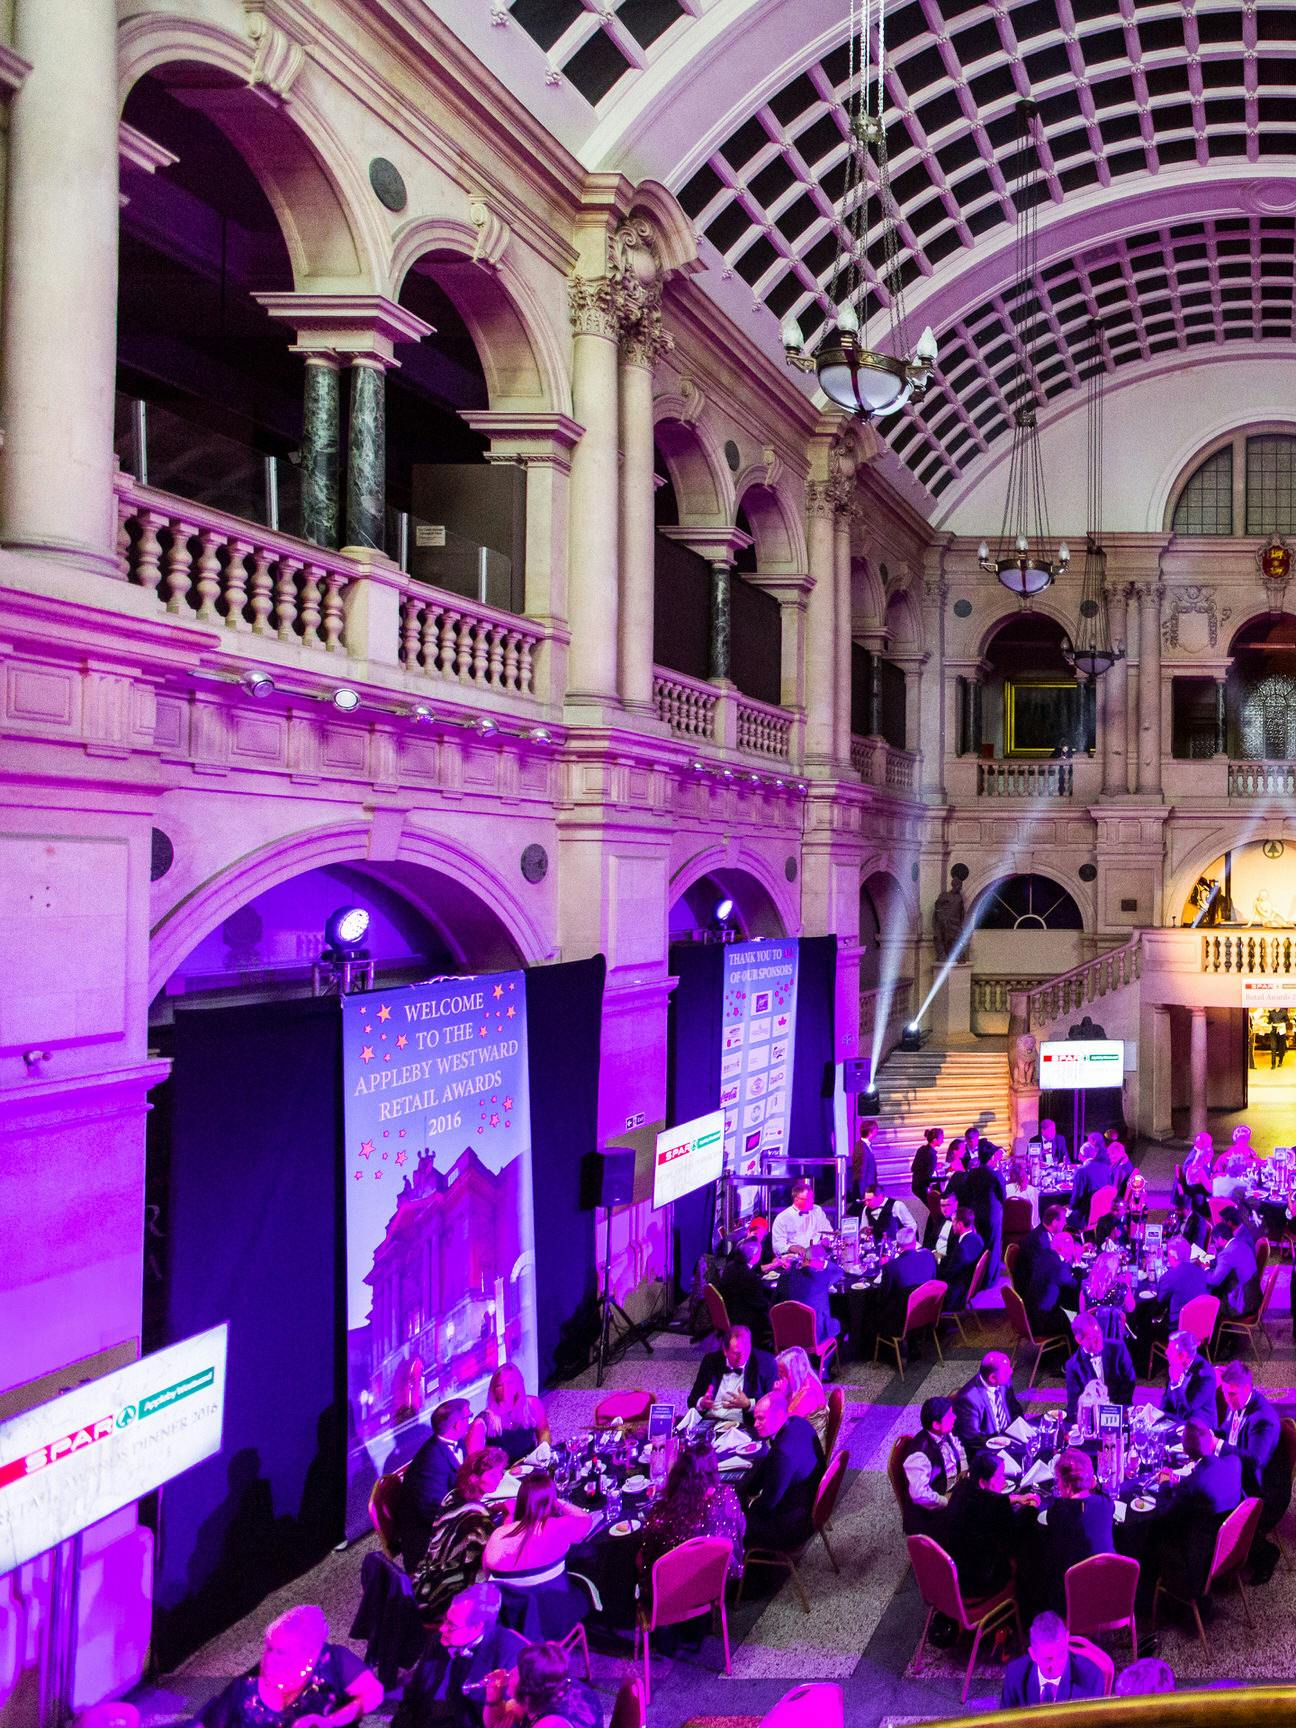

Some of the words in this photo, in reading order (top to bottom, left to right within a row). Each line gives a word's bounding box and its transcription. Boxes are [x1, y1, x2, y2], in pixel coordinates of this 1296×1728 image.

[729, 952, 755, 965] THANK
[757, 949, 771, 962] YOU
[773, 949, 782, 960] TO
[730, 971, 741, 984] OF
[742, 968, 758, 981] OUR
[759, 964, 792, 979] SPONSORS
[405, 992, 484, 1022] WELCOME
[416, 1031, 440, 1050] TO
[443, 1023, 474, 1044] THE
[354, 1059, 433, 1096] APPLEBY
[436, 1039, 519, 1075] WESTWARD
[379, 1089, 439, 1121] RETAIL
[442, 1070, 502, 1104] AWARDS
[429, 1112, 461, 1136] 2016
[666, 1143, 691, 1162] SPAR
[25, 1416, 113, 1474] SPAR
